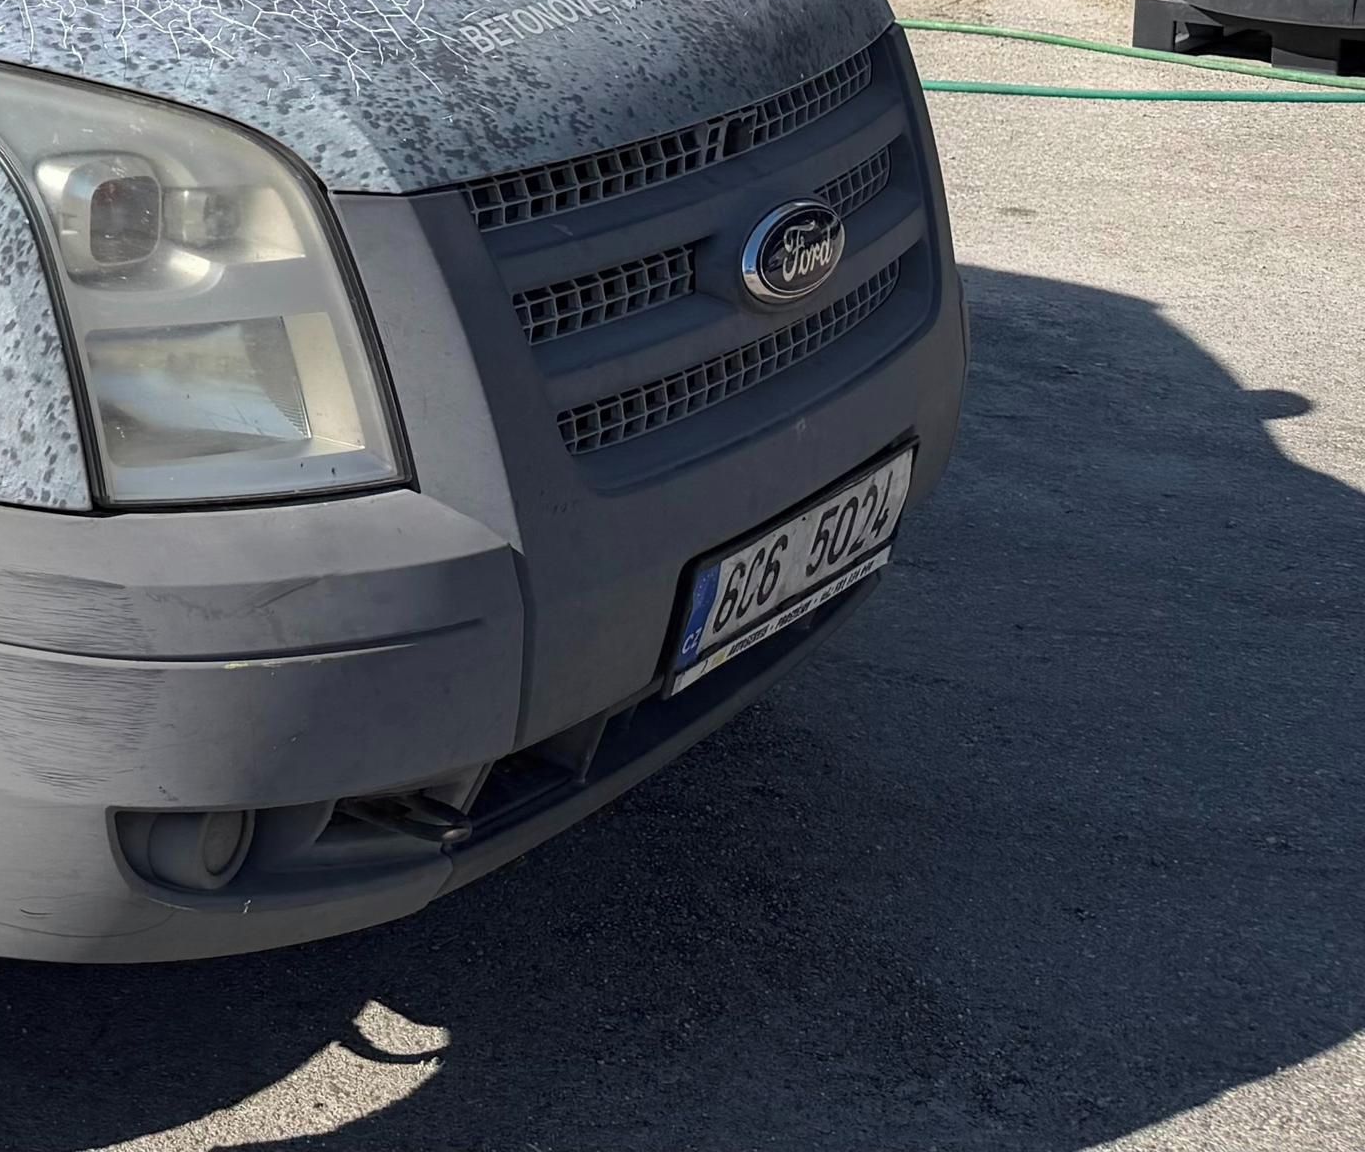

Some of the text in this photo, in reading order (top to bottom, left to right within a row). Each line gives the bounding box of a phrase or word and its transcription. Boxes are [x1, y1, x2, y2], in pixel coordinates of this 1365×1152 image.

[782, 219, 833, 282] Ford
[712, 533, 789, 634] 6C6
[805, 469, 894, 578] 5024
[681, 626, 702, 655] CZ
